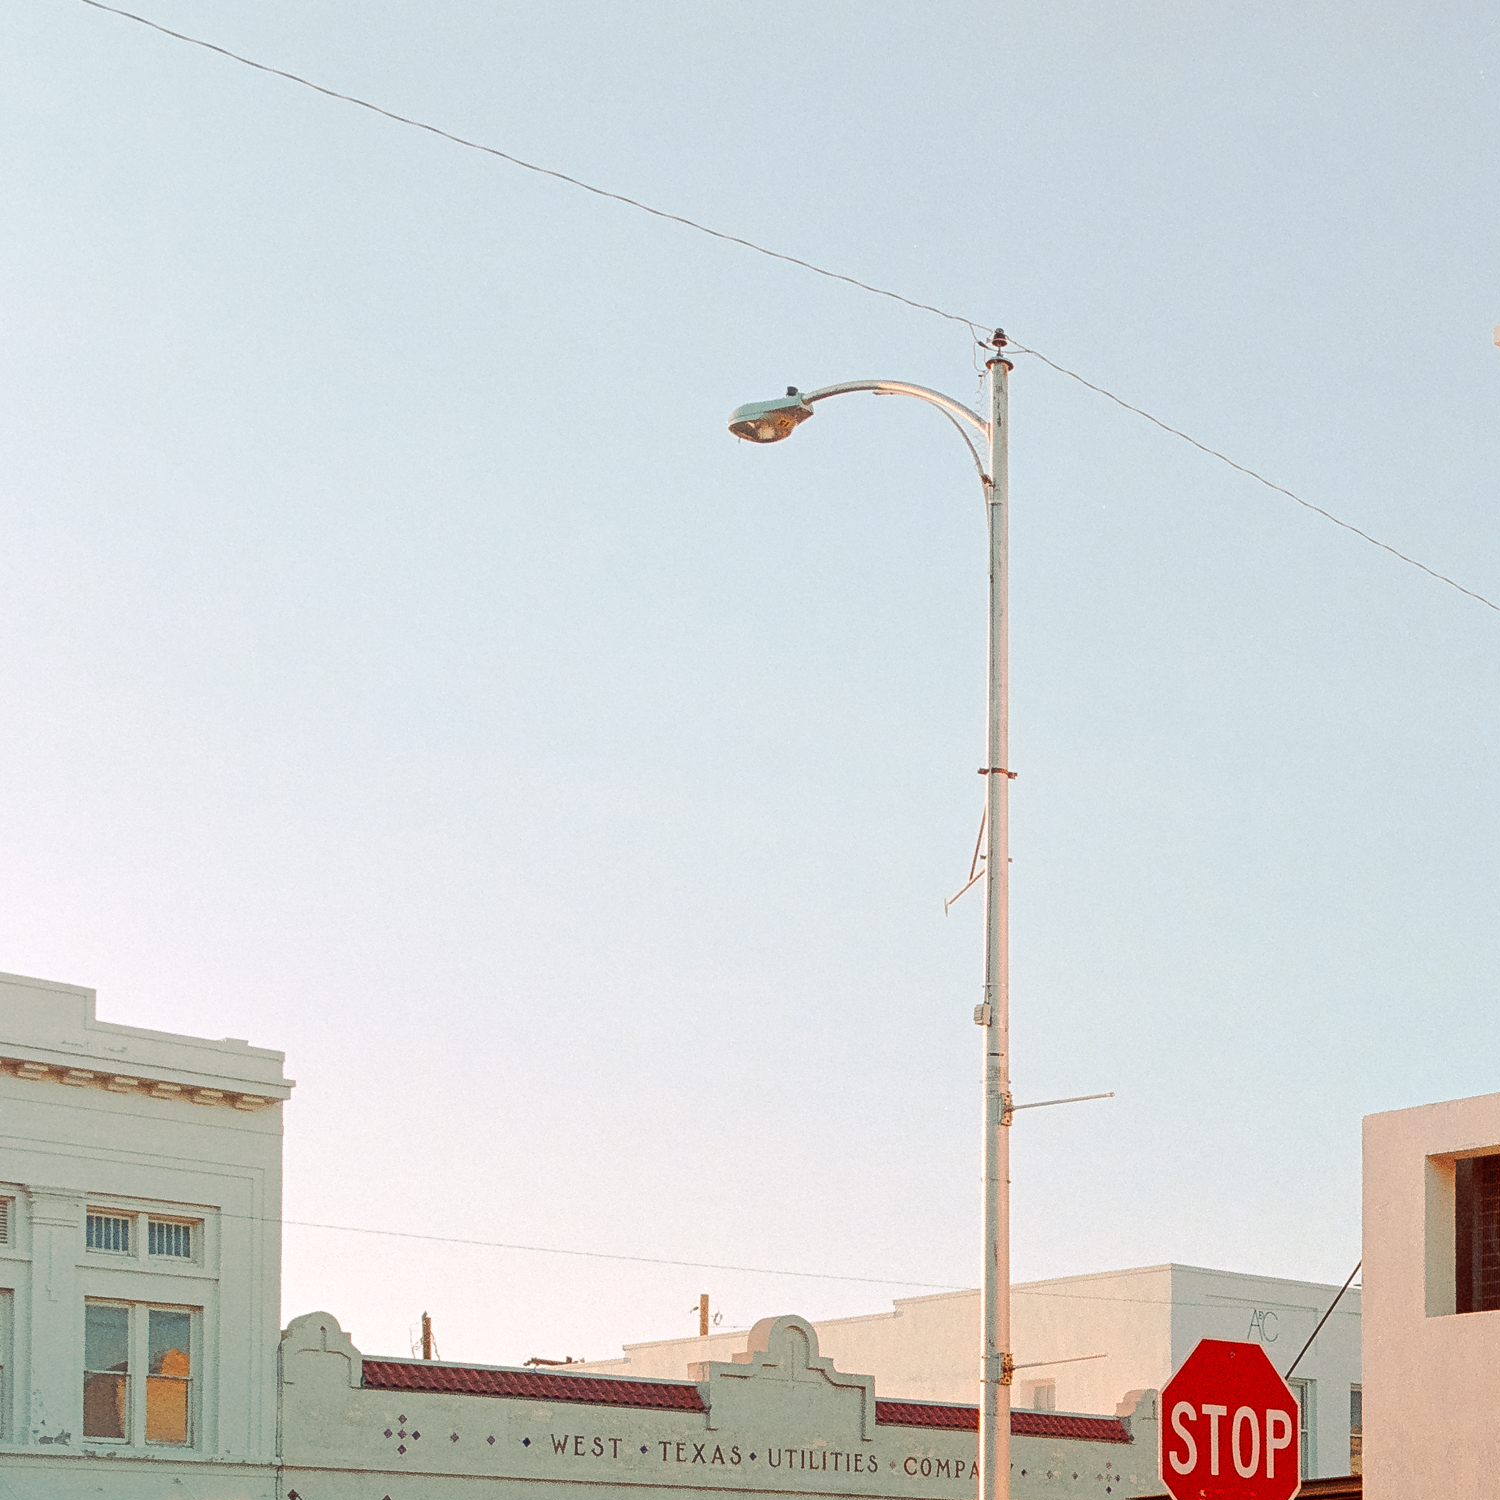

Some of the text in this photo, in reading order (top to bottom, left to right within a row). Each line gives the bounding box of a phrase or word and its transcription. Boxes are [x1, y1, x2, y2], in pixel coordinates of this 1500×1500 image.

[550, 1433, 1014, 1480] WEST TEXAS UTILITIES COMPA
[1168, 1400, 1293, 1479] STOP
